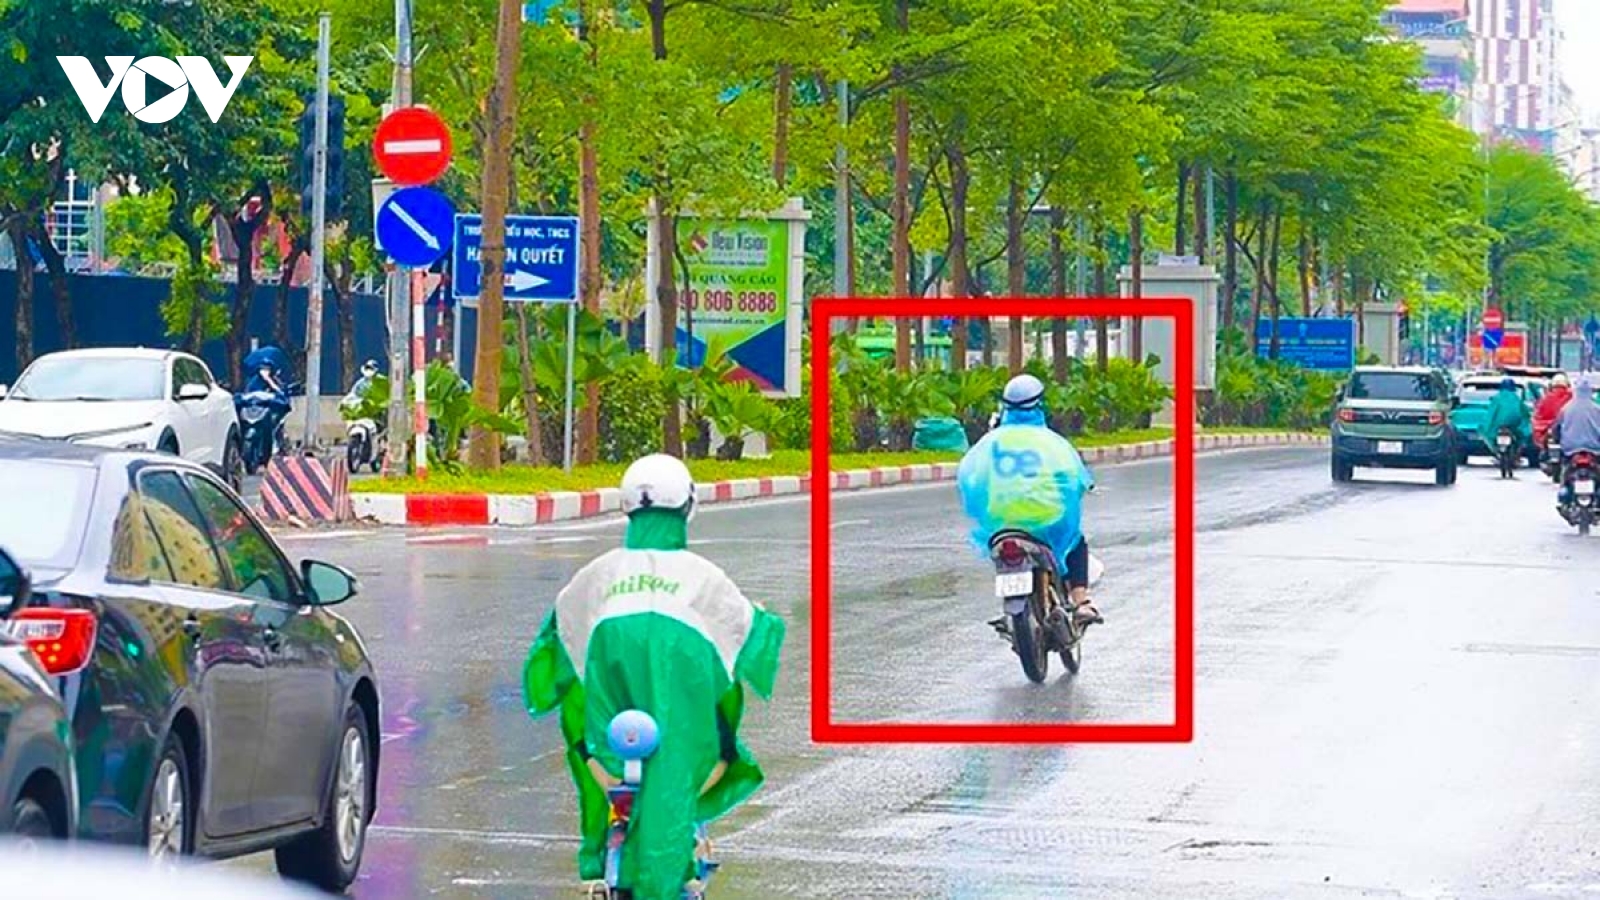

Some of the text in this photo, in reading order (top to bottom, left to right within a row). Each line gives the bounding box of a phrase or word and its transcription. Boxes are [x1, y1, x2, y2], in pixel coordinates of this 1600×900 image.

[521, 244, 565, 265] QUYẾT
[704, 289, 733, 311] 806
[738, 291, 777, 313] 8888
[992, 441, 1041, 477] be
